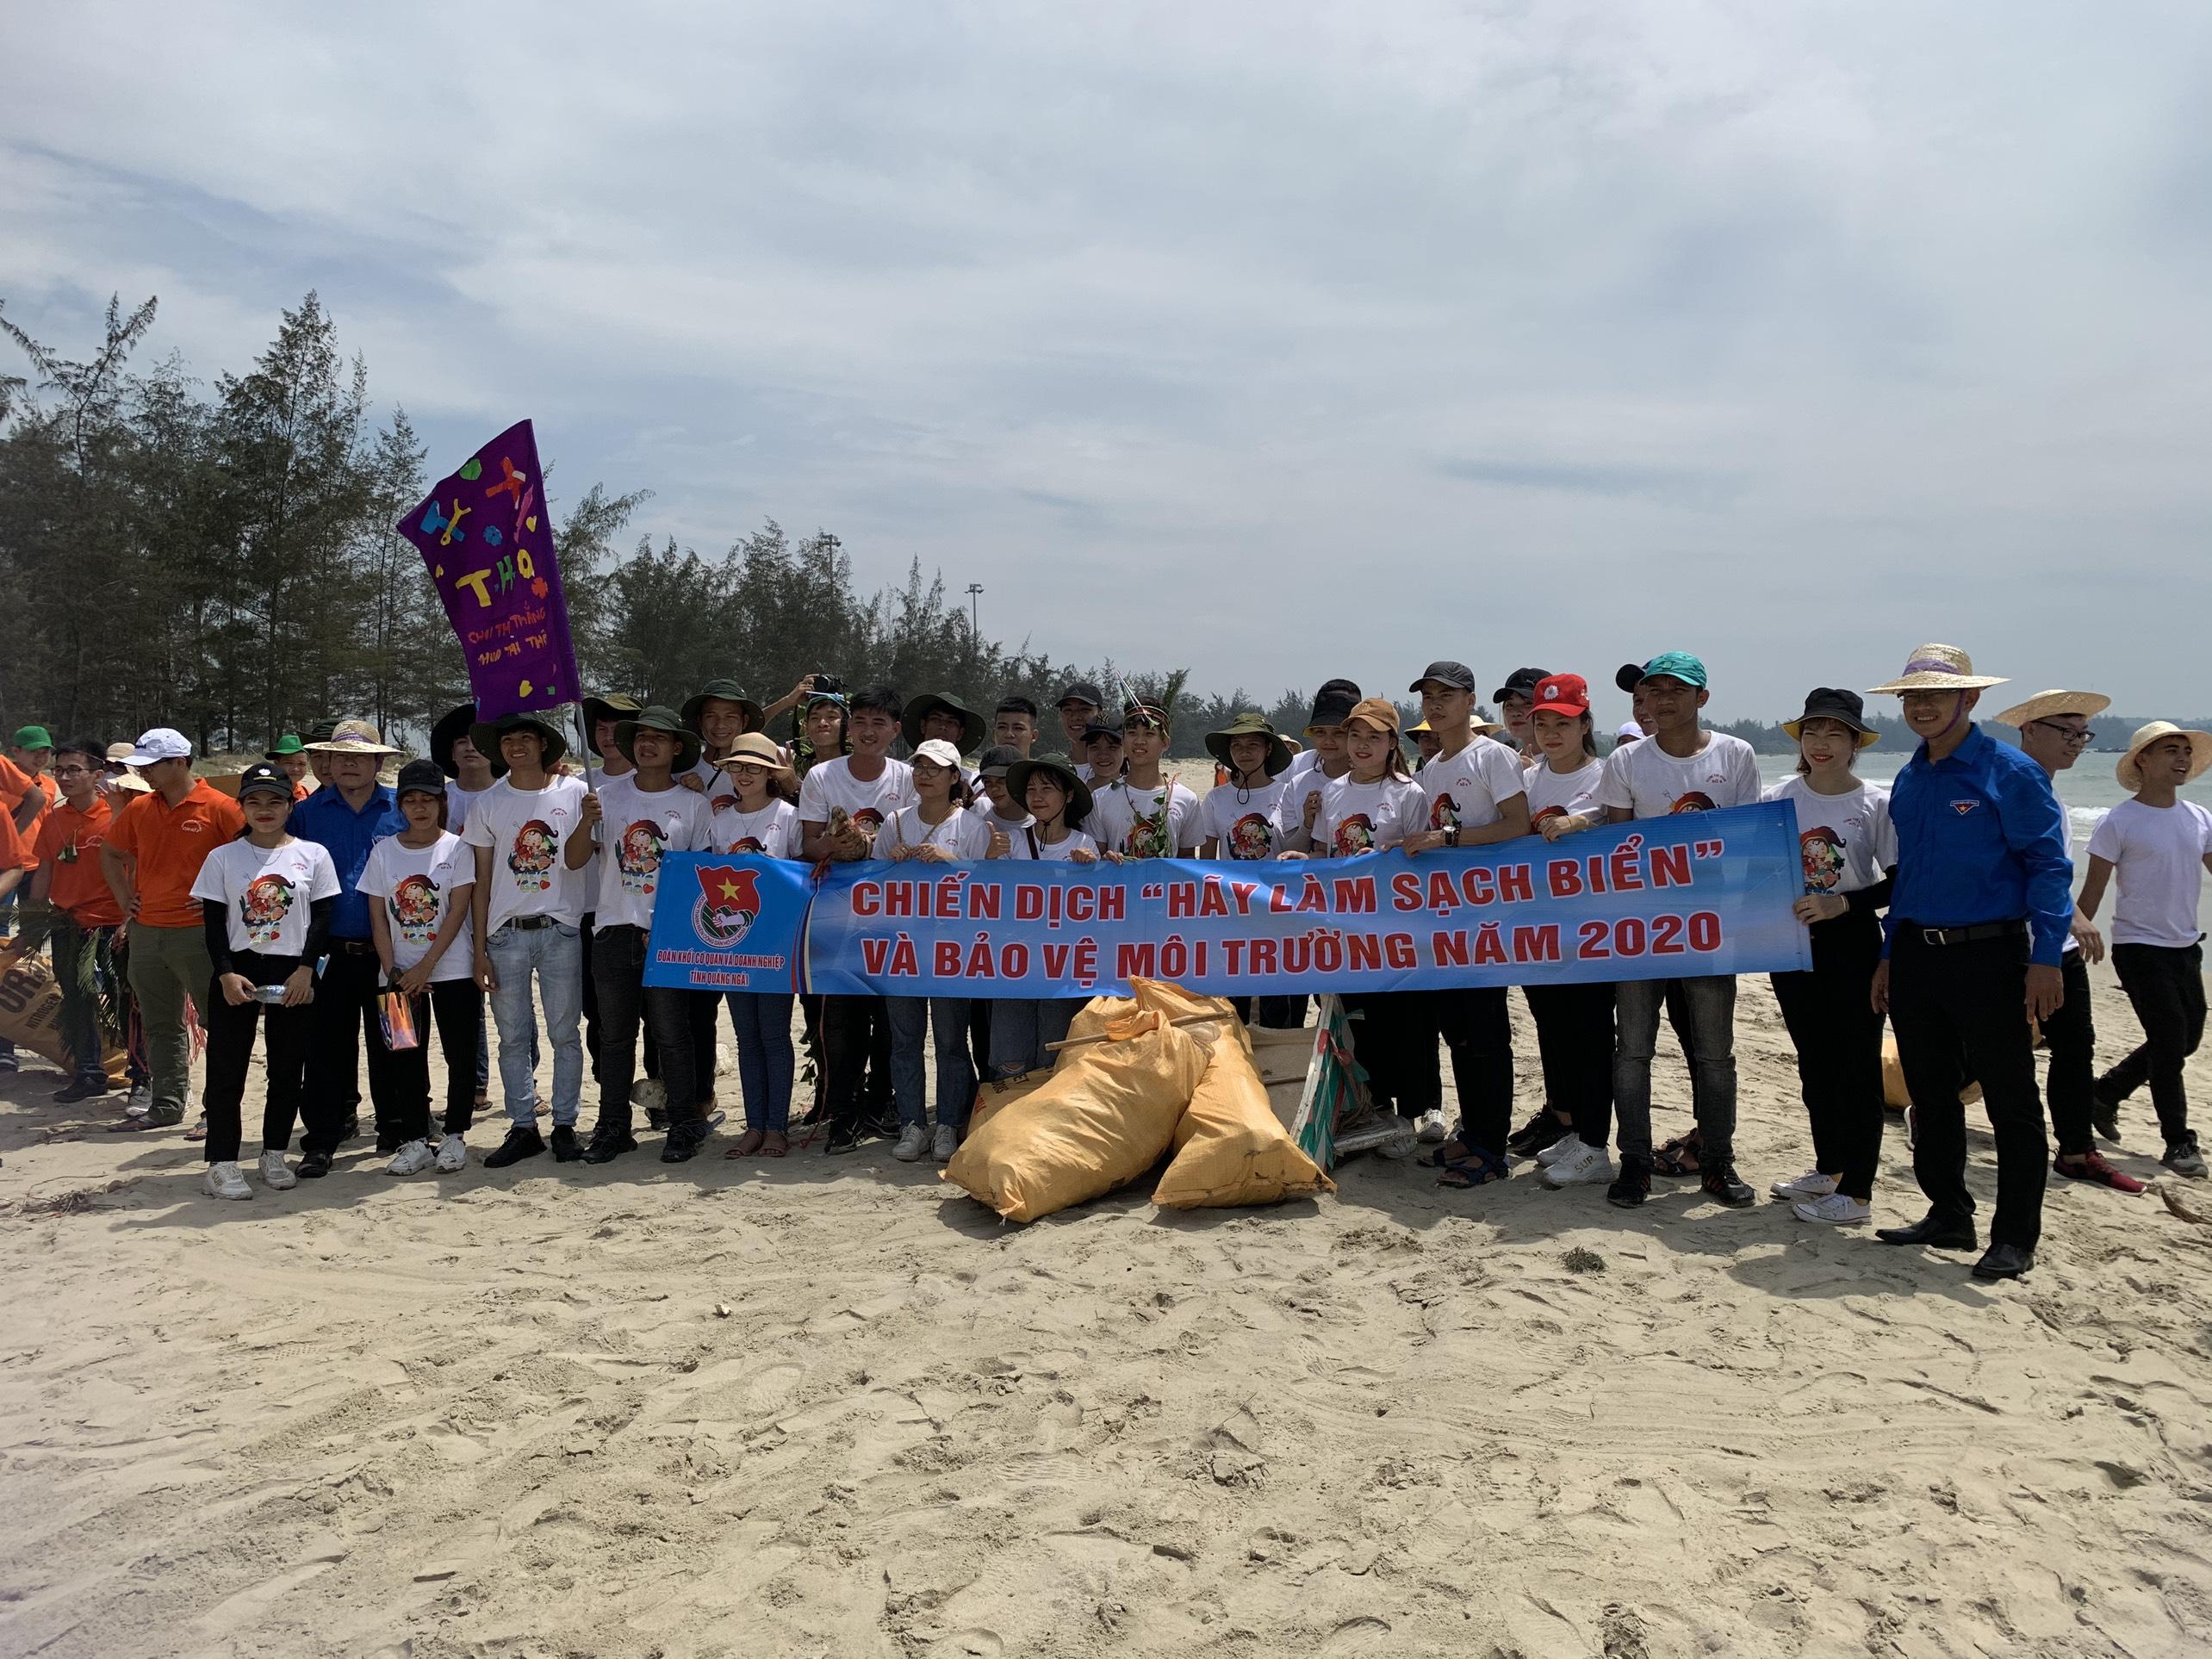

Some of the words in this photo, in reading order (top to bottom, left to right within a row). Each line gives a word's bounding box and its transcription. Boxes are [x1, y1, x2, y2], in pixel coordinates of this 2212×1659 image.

[851, 872, 1002, 919] CHIẾN
[1015, 885, 1125, 928] DỊCH
[1270, 873, 1377, 914] LÀM
[1391, 863, 1534, 916] SẠCH
[657, 948, 677, 962] ĐOÀN
[677, 948, 693, 963] KHỐI
[695, 951, 705, 965] CƠ
[705, 953, 723, 966] QUAN
[724, 951, 733, 966] VÀ
[734, 954, 756, 967] DOANH
[758, 954, 785, 971] NGHIỆP
[861, 932, 919, 976] VÀ
[934, 932, 1029, 979] BẢO
[1041, 937, 1098, 987] VỆ
[1116, 935, 1206, 979] MÔI
[1221, 928, 1417, 976] TRƯỜNG
[1432, 922, 1561, 967] NĂM
[1578, 910, 1722, 960] 2020
[730, 971, 749, 986] NGÃI
[1574, 1155, 1594, 1173] SUP
